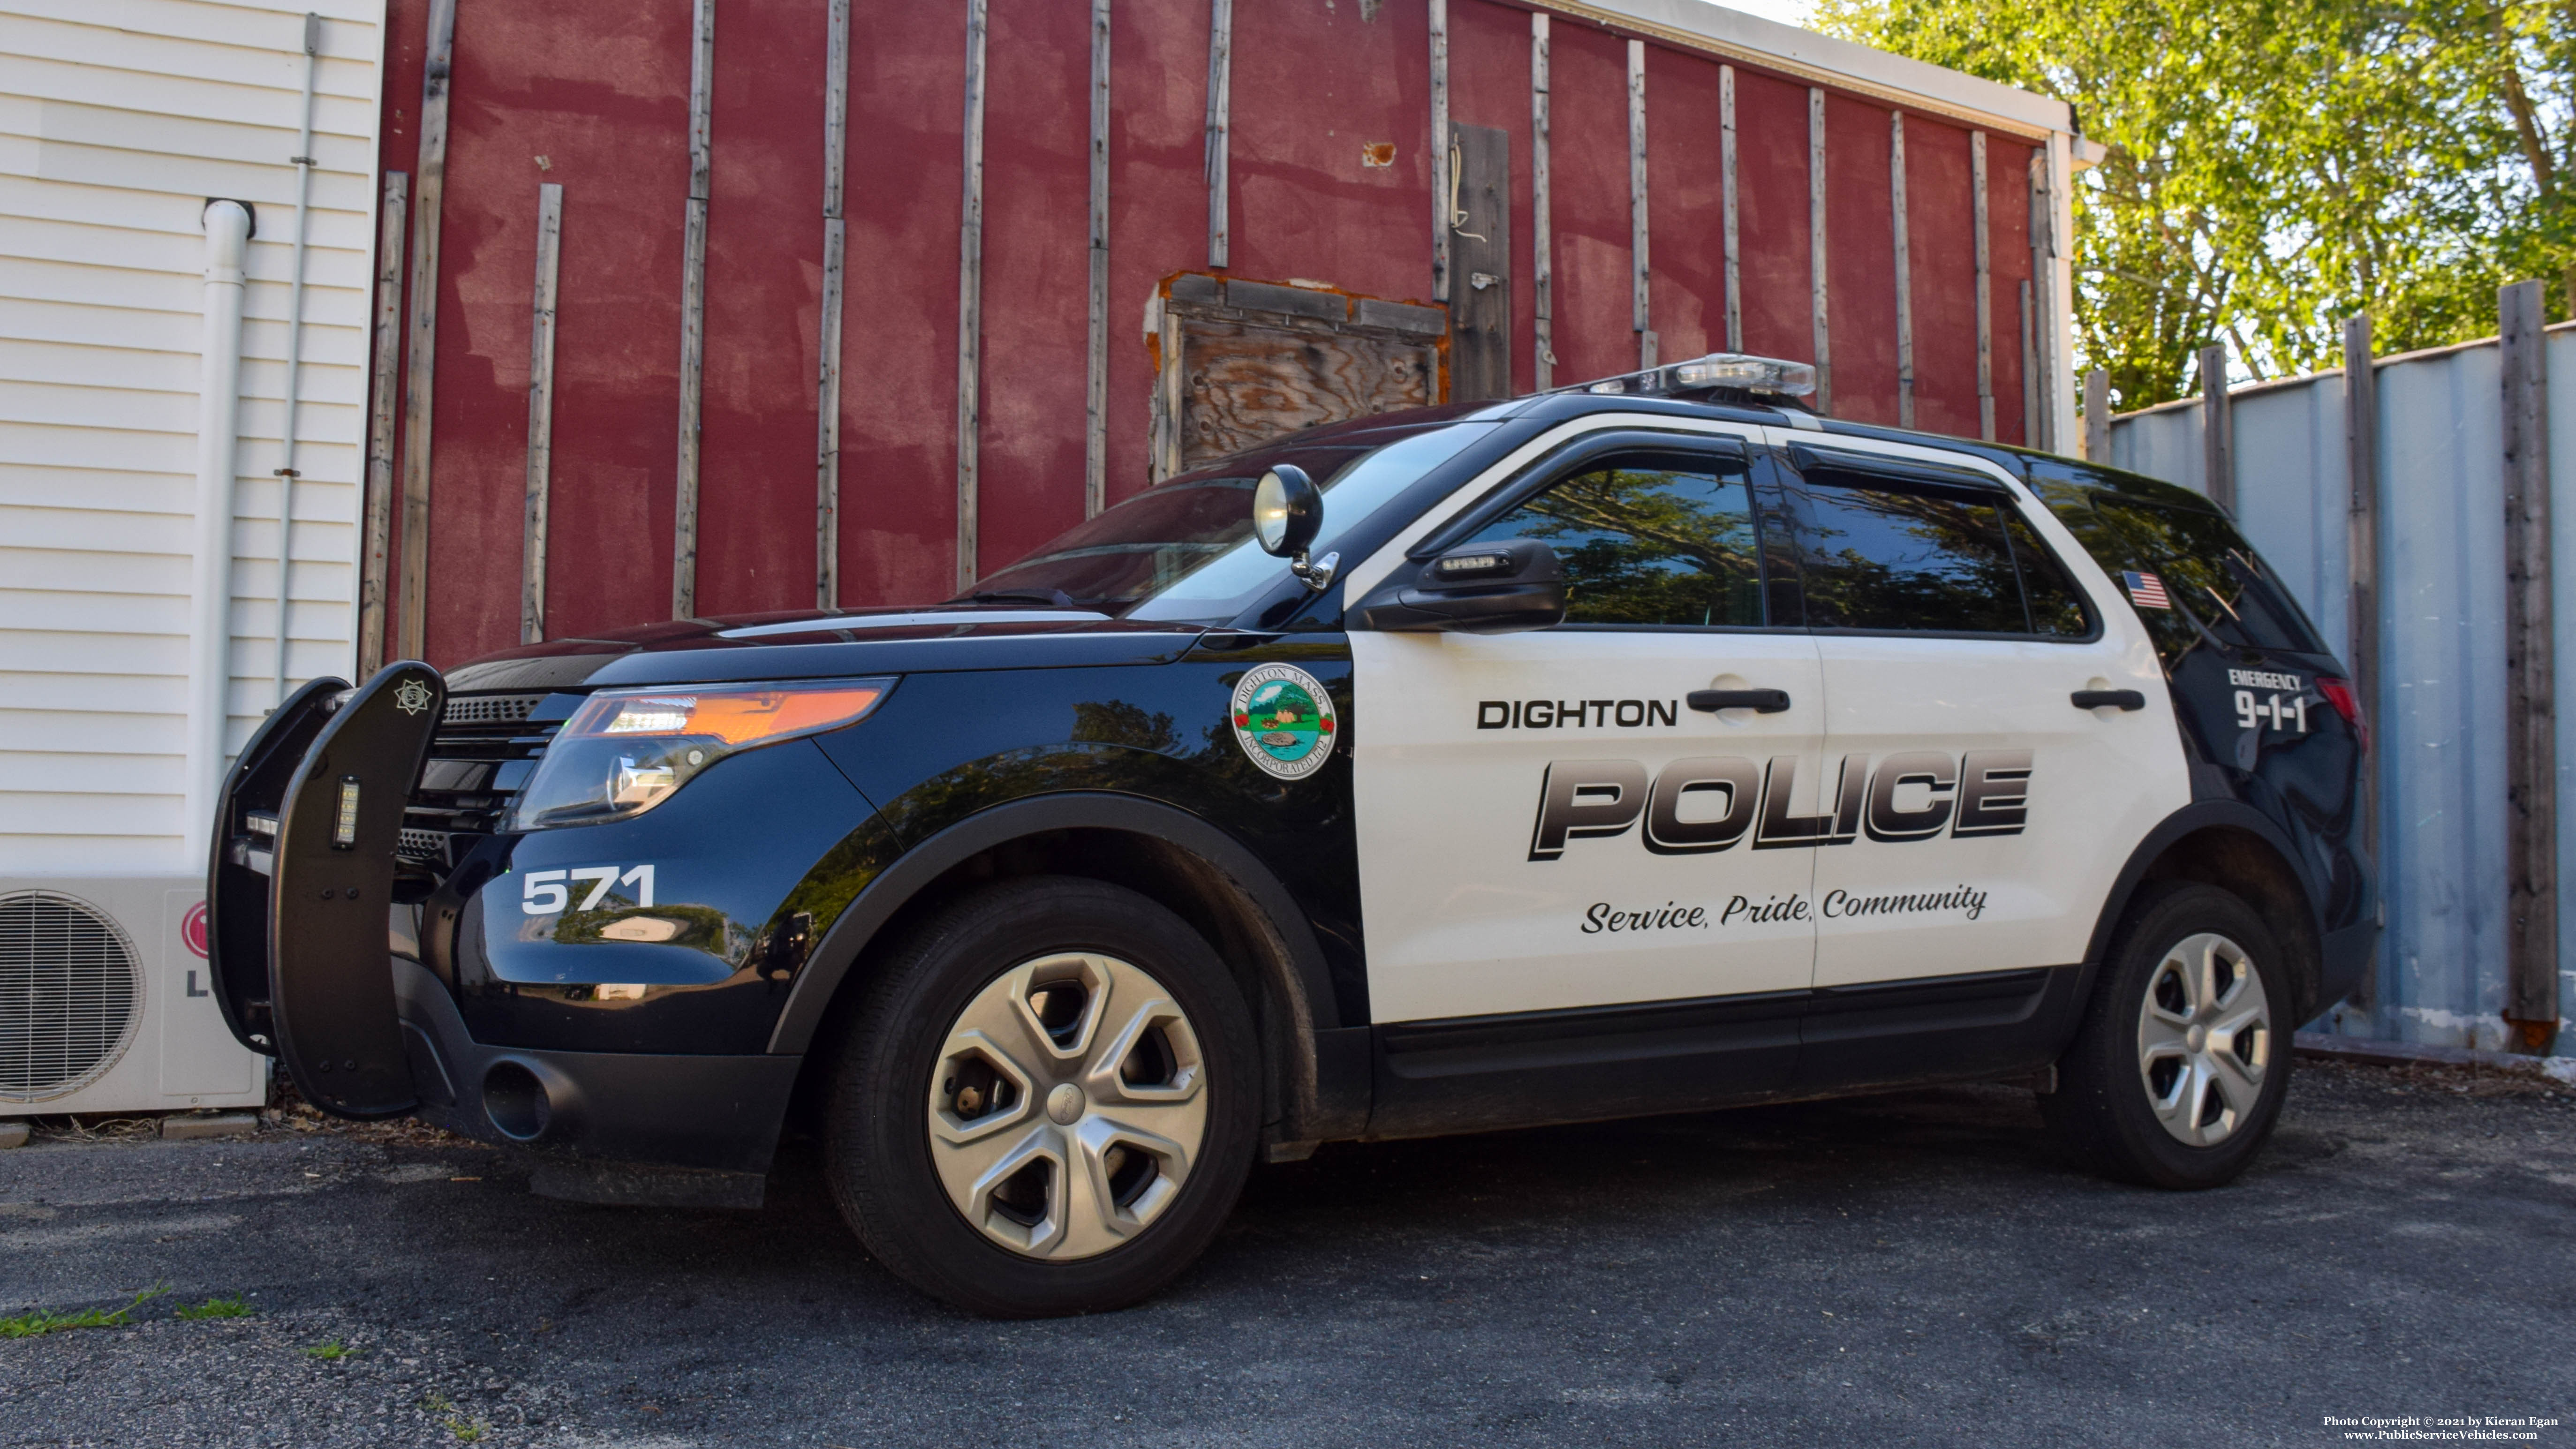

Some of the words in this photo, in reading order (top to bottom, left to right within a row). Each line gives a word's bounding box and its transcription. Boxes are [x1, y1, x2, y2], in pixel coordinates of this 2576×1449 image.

[1239, 668, 1286, 704] DIGHTON
[2228, 668, 2301, 691] EMERGENCY
[1477, 700, 1677, 730] DIGHTON
[2234, 690, 2306, 732] 9-1-1
[1244, 736, 1313, 773] INCORPORATED
[1313, 740, 1327, 759] 1712
[1527, 749, 2036, 862] POLICE
[521, 864, 655, 915] 571
[1580, 901, 1708, 934] Service,
[1720, 893, 1812, 925] Pride,
[1823, 884, 1987, 920] Community
